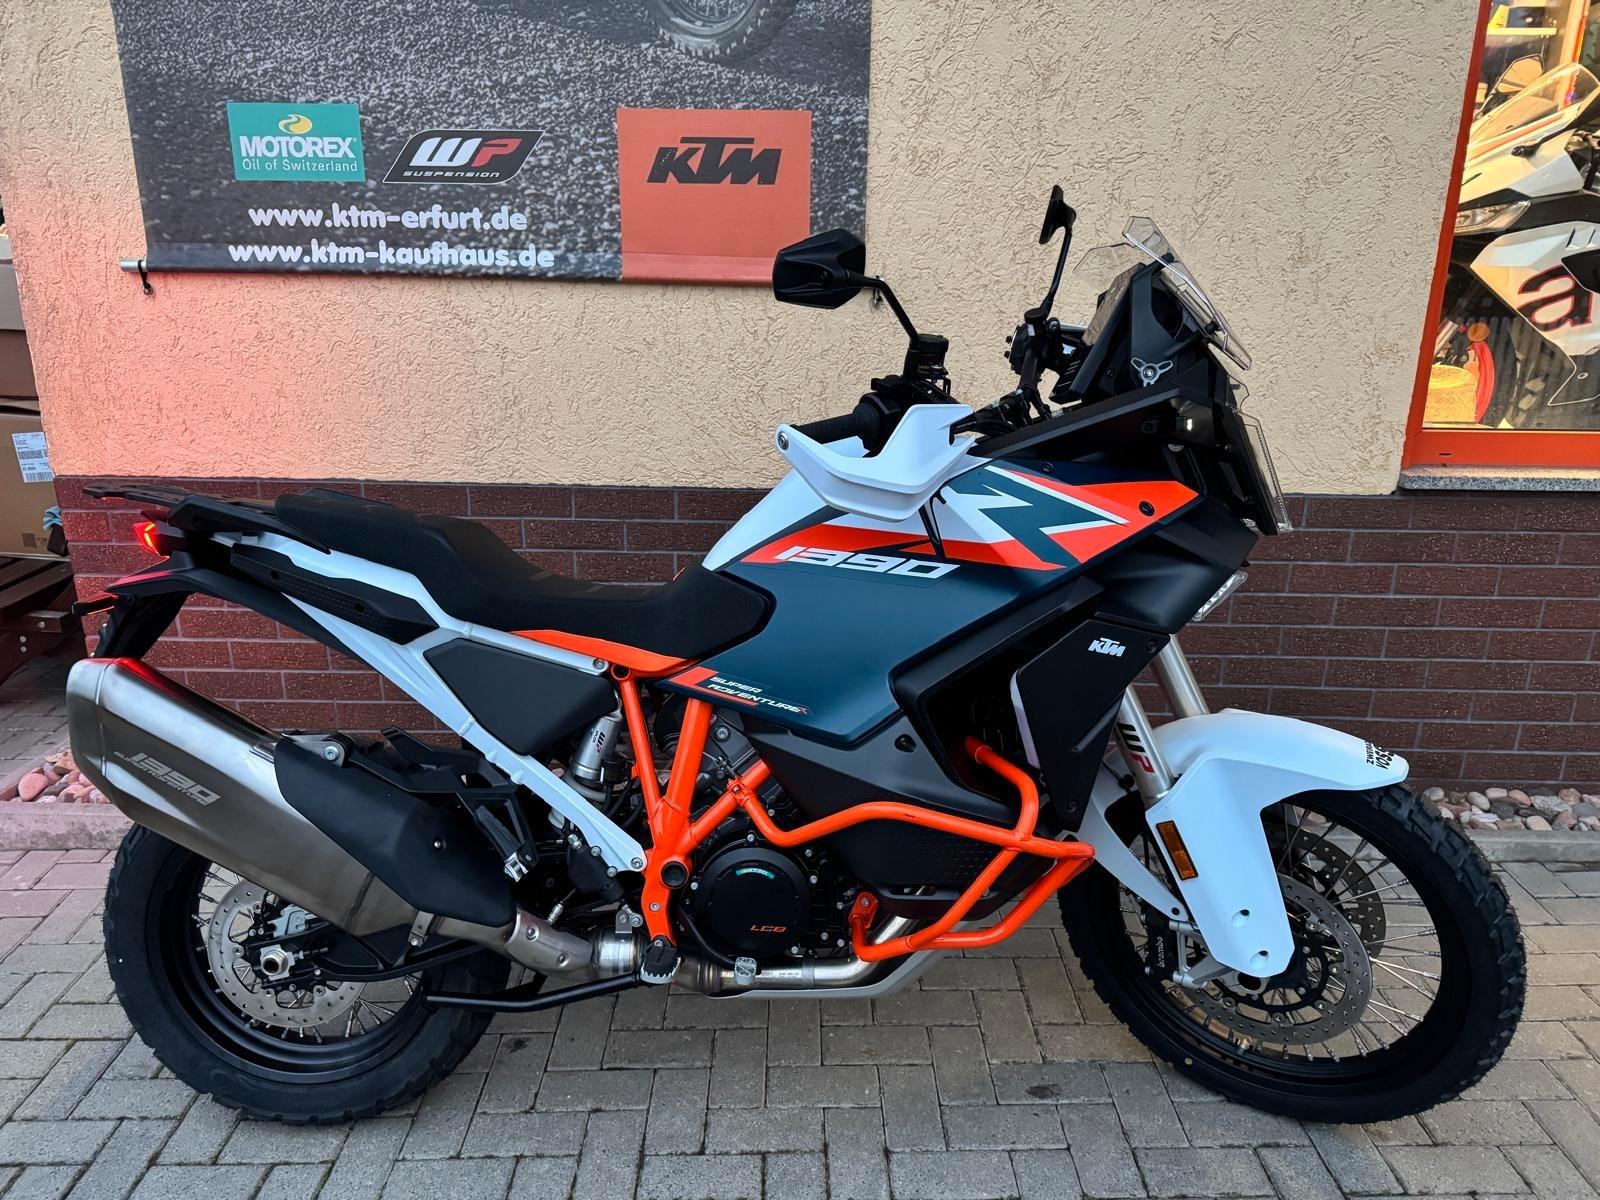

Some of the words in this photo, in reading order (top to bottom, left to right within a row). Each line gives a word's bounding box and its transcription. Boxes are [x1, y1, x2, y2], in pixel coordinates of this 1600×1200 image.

[239, 135, 354, 158] MOTOREX
[409, 137, 522, 167] WP
[646, 136, 782, 185] KTM
[242, 159, 260, 171] Oil
[265, 159, 277, 171] of
[282, 159, 358, 172] Switzerland
[248, 202, 528, 230] www.ktm-erfurt.de
[228, 238, 555, 268] www.ktm-kaufhaus.de
[774, 545, 961, 579] 1390
[1088, 637, 1126, 657] KTM
[709, 676, 763, 693] SUPER
[1116, 722, 1155, 773] WP
[130, 752, 221, 803] 1390
